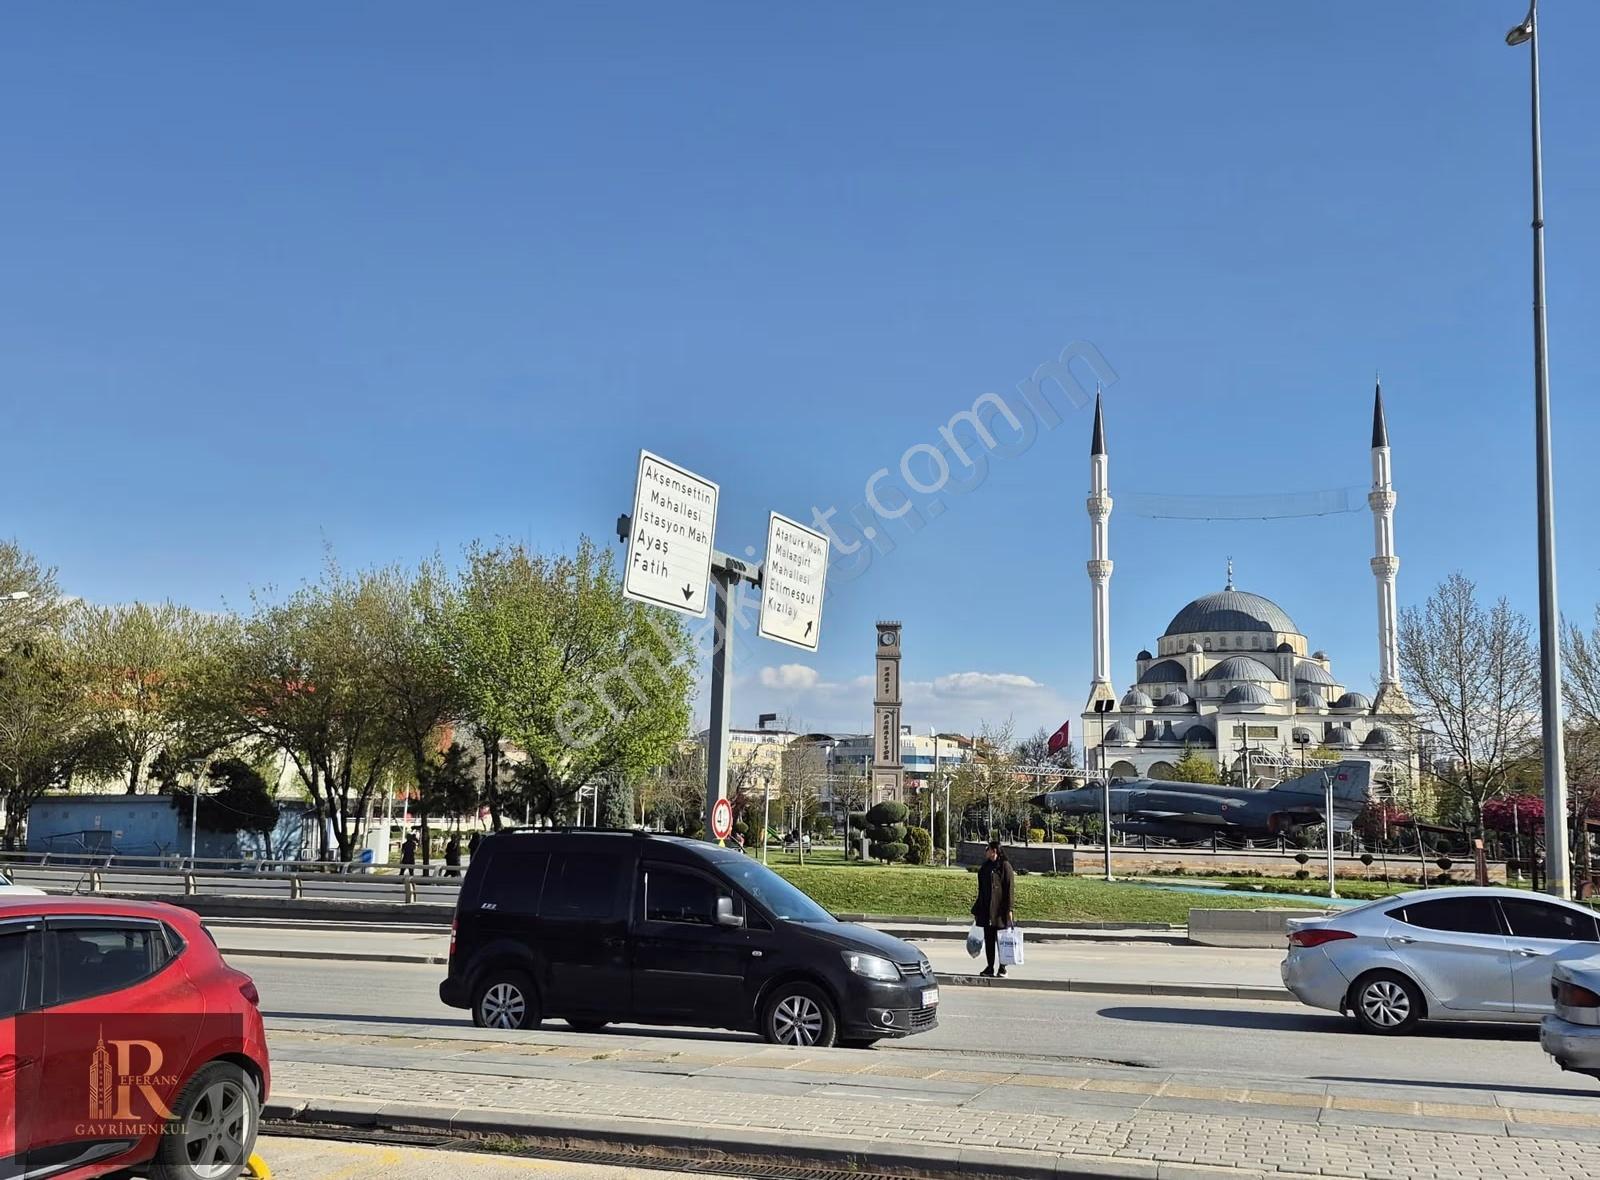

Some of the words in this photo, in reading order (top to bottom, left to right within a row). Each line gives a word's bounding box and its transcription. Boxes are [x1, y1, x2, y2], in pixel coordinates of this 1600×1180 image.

[645, 465, 711, 504] Akşemsettin
[639, 503, 685, 536] İstasyon
[650, 490, 702, 522] Mahallesi
[637, 528, 669, 555] Ayaş
[633, 552, 668, 578] Fatih
[769, 578, 815, 605] Etimesgut
